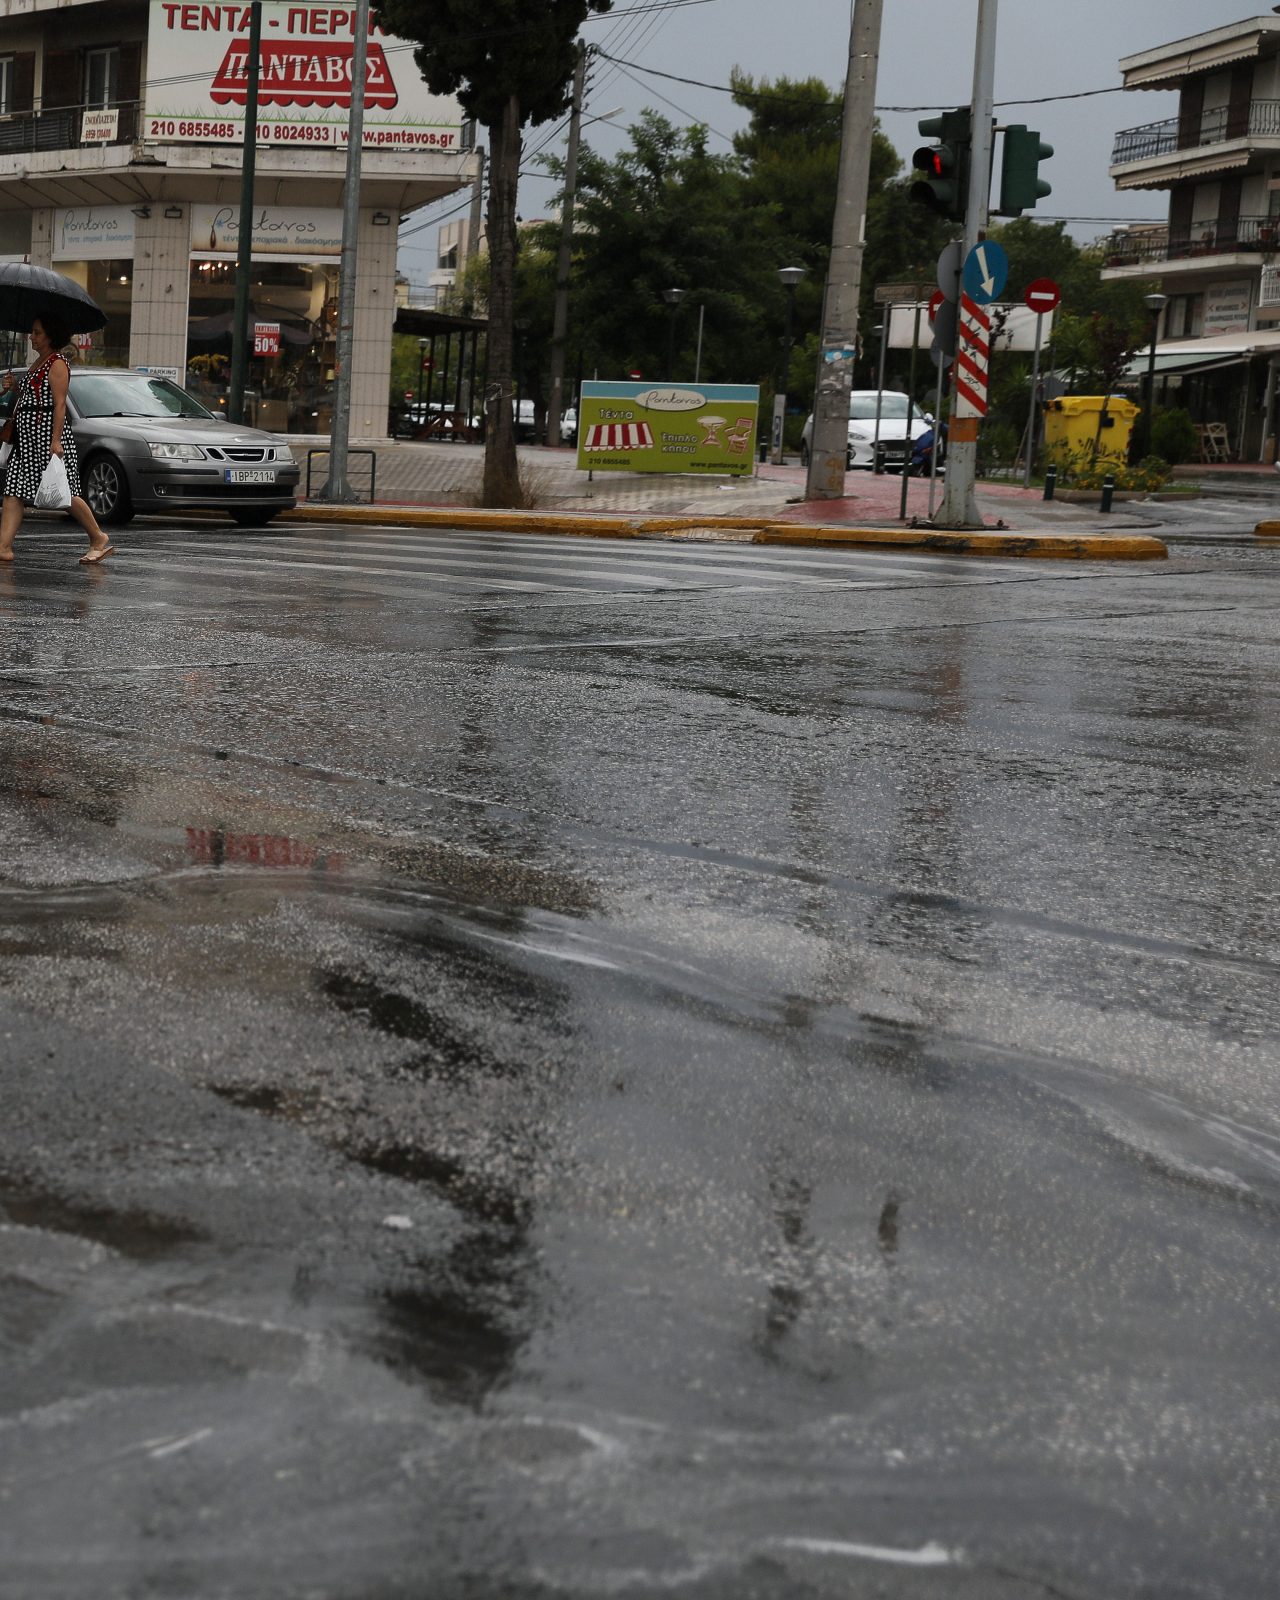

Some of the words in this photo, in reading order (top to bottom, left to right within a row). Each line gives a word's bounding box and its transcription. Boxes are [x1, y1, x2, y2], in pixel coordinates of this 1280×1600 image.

[162, 4, 252, 32] ΤΕΝΤΑ
[151, 121, 175, 136] 210
[179, 122, 234, 138] 6855485
[255, 125, 270, 139] 10
[274, 125, 329, 142] 8024933
[341, 130, 455, 148] ww.pantavos.gr
[210, 208, 316, 249] Patavos
[255, 337, 278, 353] 50%
